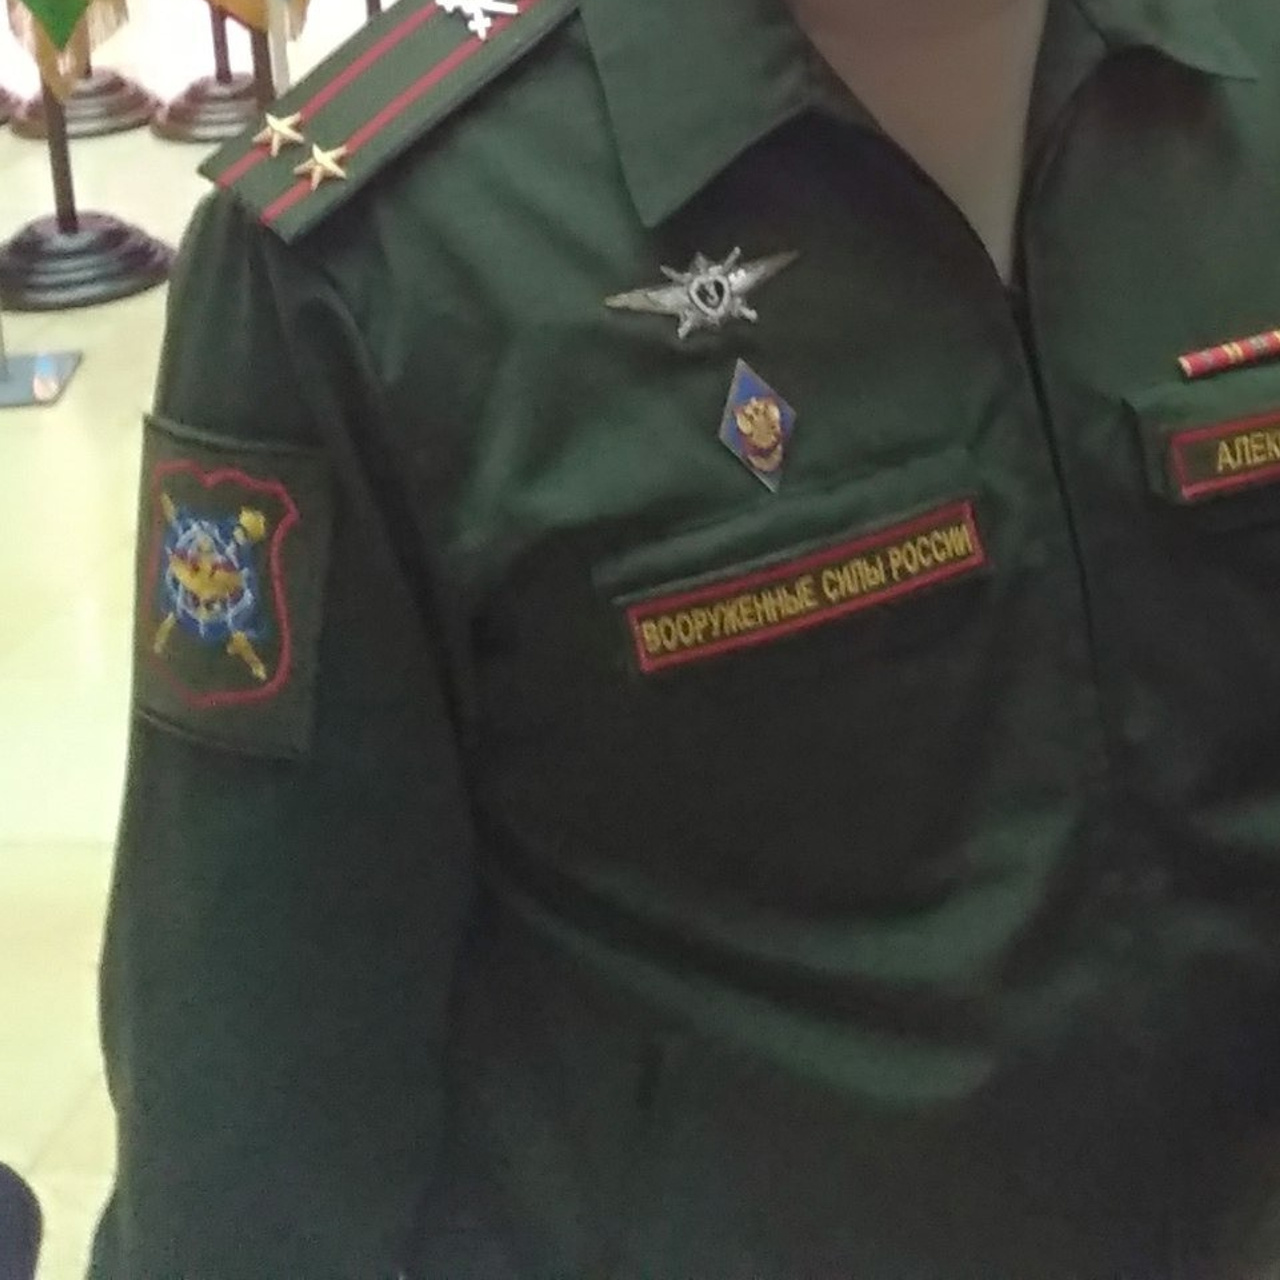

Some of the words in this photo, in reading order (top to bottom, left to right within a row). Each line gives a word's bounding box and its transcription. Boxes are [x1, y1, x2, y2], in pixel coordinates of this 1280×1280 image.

[641, 575, 818, 653] ВООРУЖЕННЫЕ
[821, 555, 886, 602] СИЛЫ
[887, 524, 973, 581] РОССИИ
